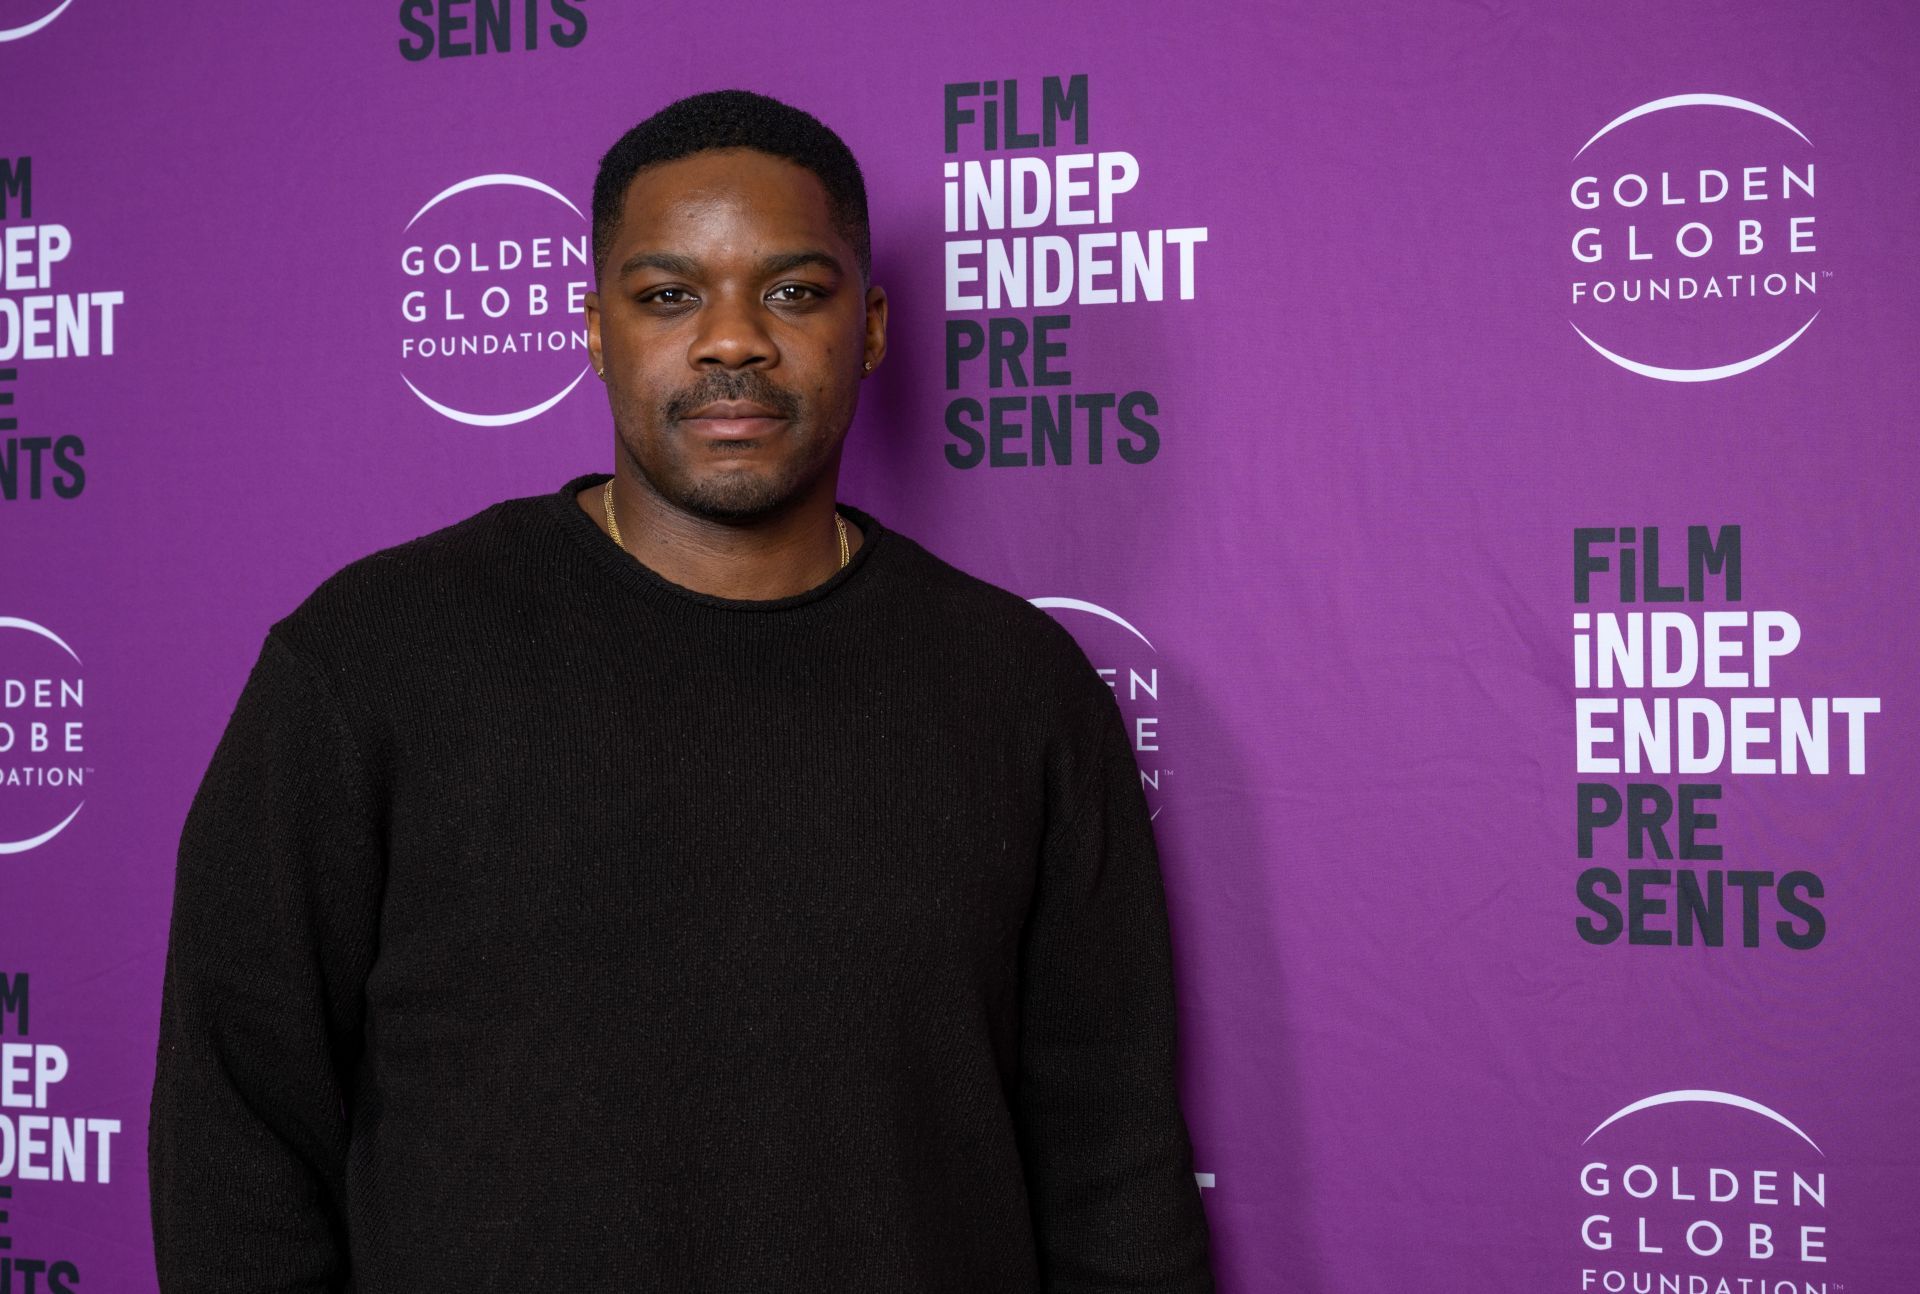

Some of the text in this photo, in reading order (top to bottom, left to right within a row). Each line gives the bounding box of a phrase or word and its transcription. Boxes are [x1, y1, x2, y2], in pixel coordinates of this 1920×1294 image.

[945, 75, 1088, 153] FiLM
[944, 151, 1139, 232] iNDEP
[1571, 164, 1814, 209] GOLDEN
[402, 236, 586, 276] GOLDEN
[945, 227, 1208, 311] ENDENT
[1572, 217, 1816, 262] GLOBE
[402, 282, 587, 322] GLOBE
[403, 330, 588, 358] FOUNDATION
[946, 315, 1071, 389] PRE
[944, 392, 1159, 469] SENTS
[1574, 525, 1741, 602] FiLM
[1574, 611, 1801, 688] iNDEP
[1576, 698, 1880, 775] ENDENT
[1578, 784, 1722, 860] PRE
[1577, 868, 1825, 949] SENTS
[1581, 1163, 1824, 1207] GOLDEN
[1582, 1215, 1826, 1262] GLOBE
